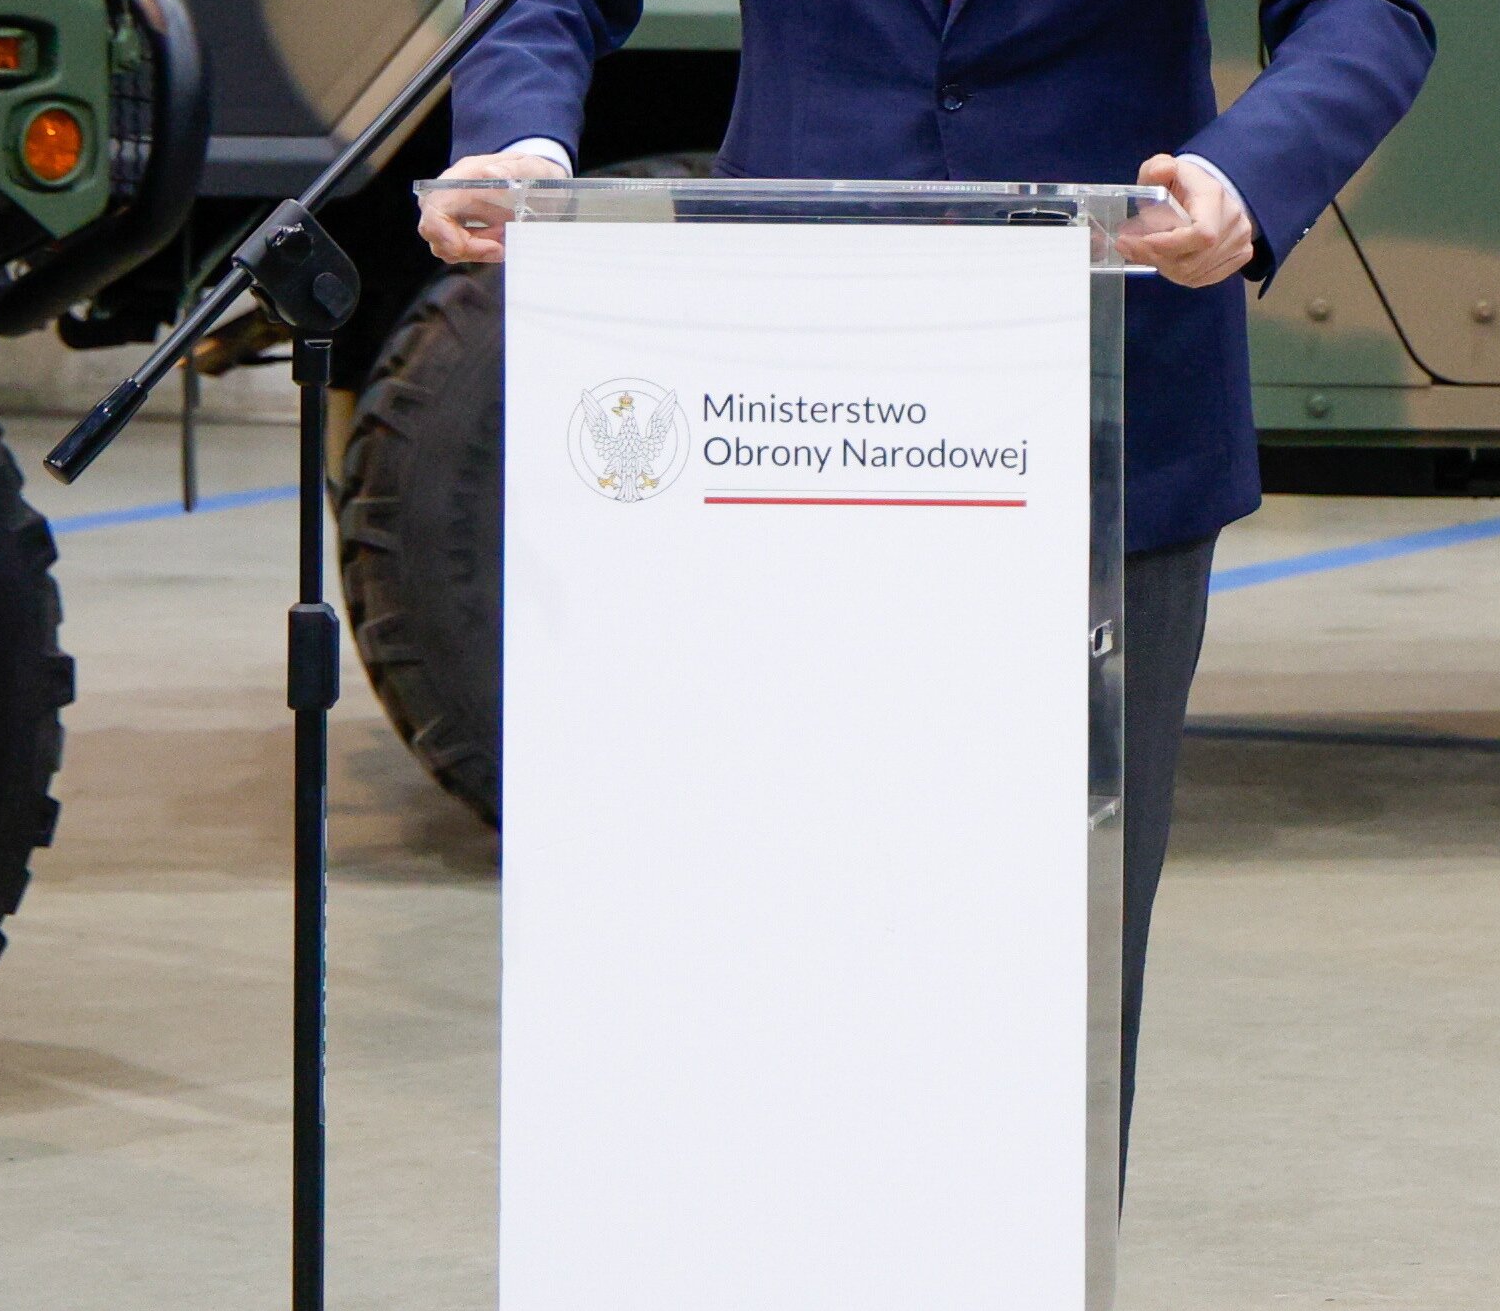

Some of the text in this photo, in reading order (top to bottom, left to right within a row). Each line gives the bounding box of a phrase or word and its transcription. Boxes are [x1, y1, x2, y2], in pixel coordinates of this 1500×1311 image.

[703, 392, 927, 425] Ministerstwo
[703, 435, 1028, 477] Obrony Narodowej
